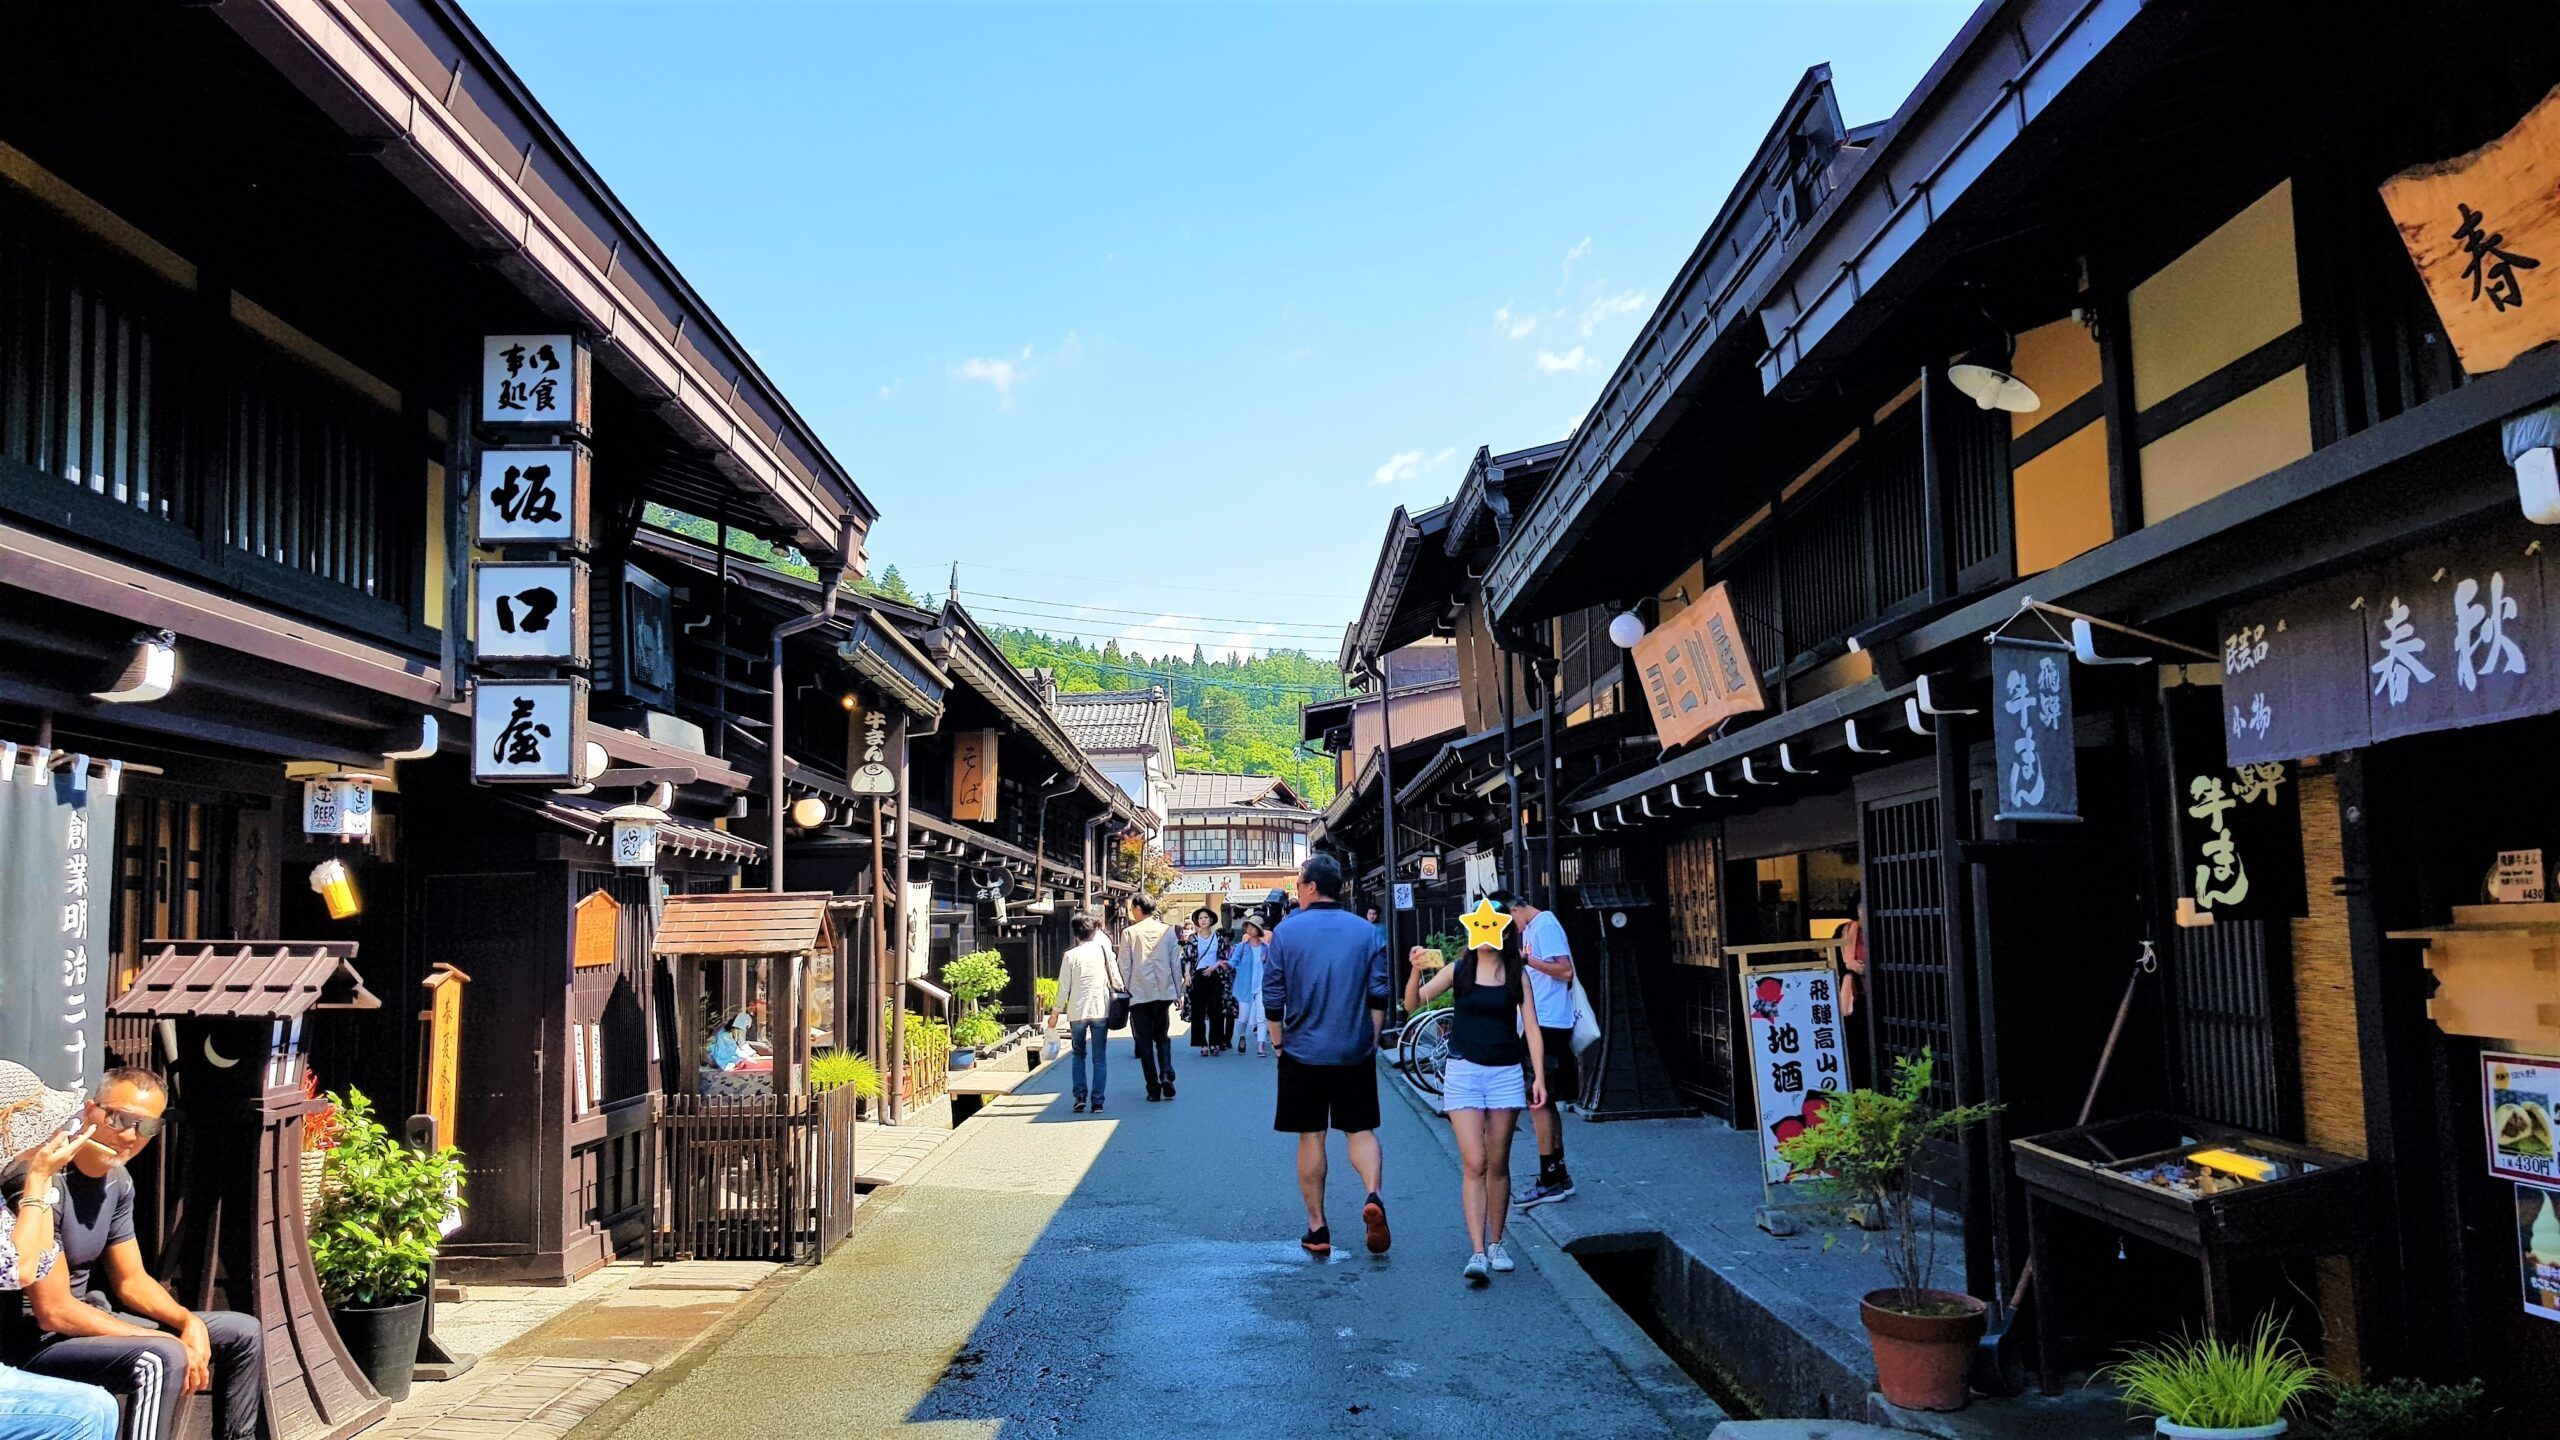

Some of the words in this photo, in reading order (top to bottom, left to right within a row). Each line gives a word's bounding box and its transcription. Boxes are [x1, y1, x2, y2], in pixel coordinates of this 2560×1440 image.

[2451, 202, 2540, 313] 春
[489, 464, 562, 766] 坂口屋
[2370, 571, 2526, 706] 春秋
[863, 710, 887, 762] 牛まん
[2005, 669, 2045, 808] 牛まん
[2037, 656, 2061, 730] 飛騨
[2233, 692, 2271, 740] 小物
[313, 804, 335, 821] BEER
[959, 746, 981, 806] そば
[2188, 774, 2250, 909] 牛まん
[62, 810, 90, 1089] 創業明治二十
[1767, 1022, 1803, 1093] 地酒
[1810, 979, 1838, 1092] 飛騨高山の
[2514, 1156, 2550, 1176] 430円
